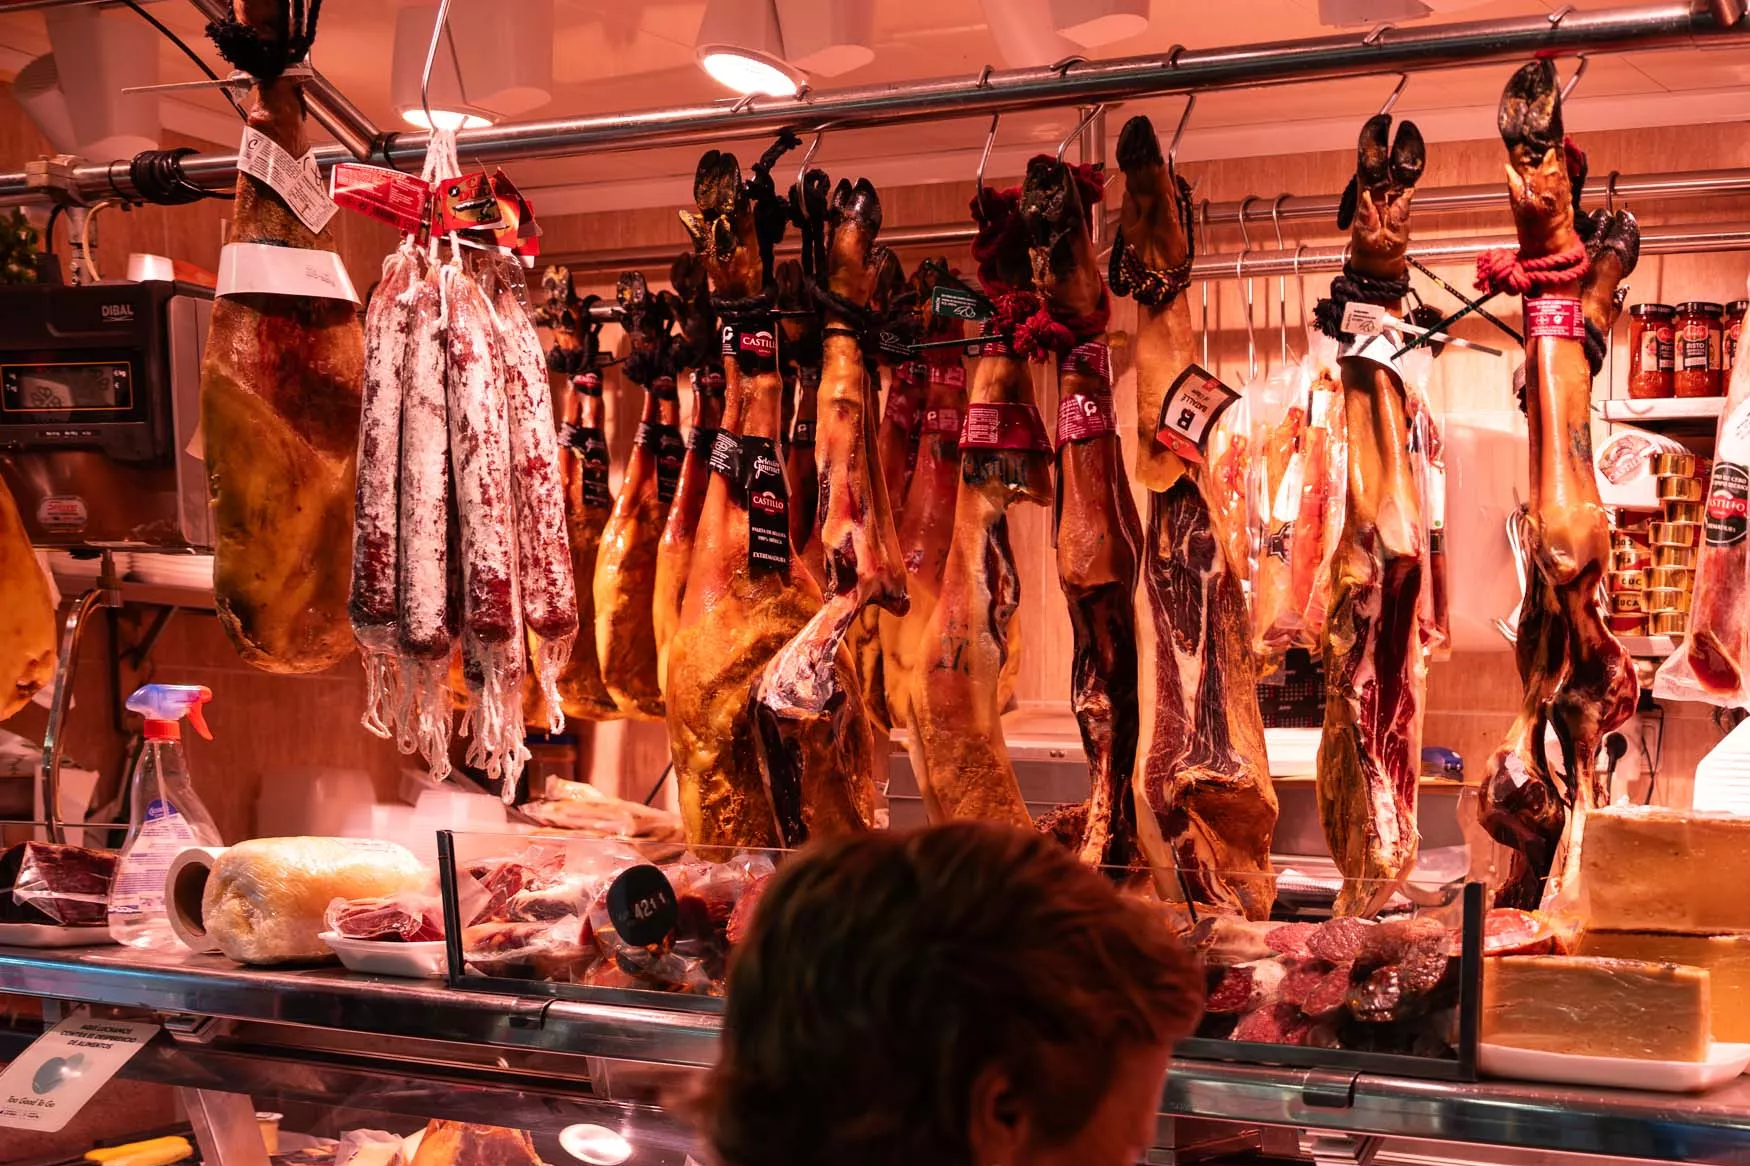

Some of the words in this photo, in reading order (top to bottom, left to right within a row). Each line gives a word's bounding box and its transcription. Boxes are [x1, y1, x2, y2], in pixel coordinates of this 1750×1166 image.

[101, 304, 134, 317] DIBAL
[752, 495, 784, 510] CASTILLO
[18, 1096, 37, 1105] Good
